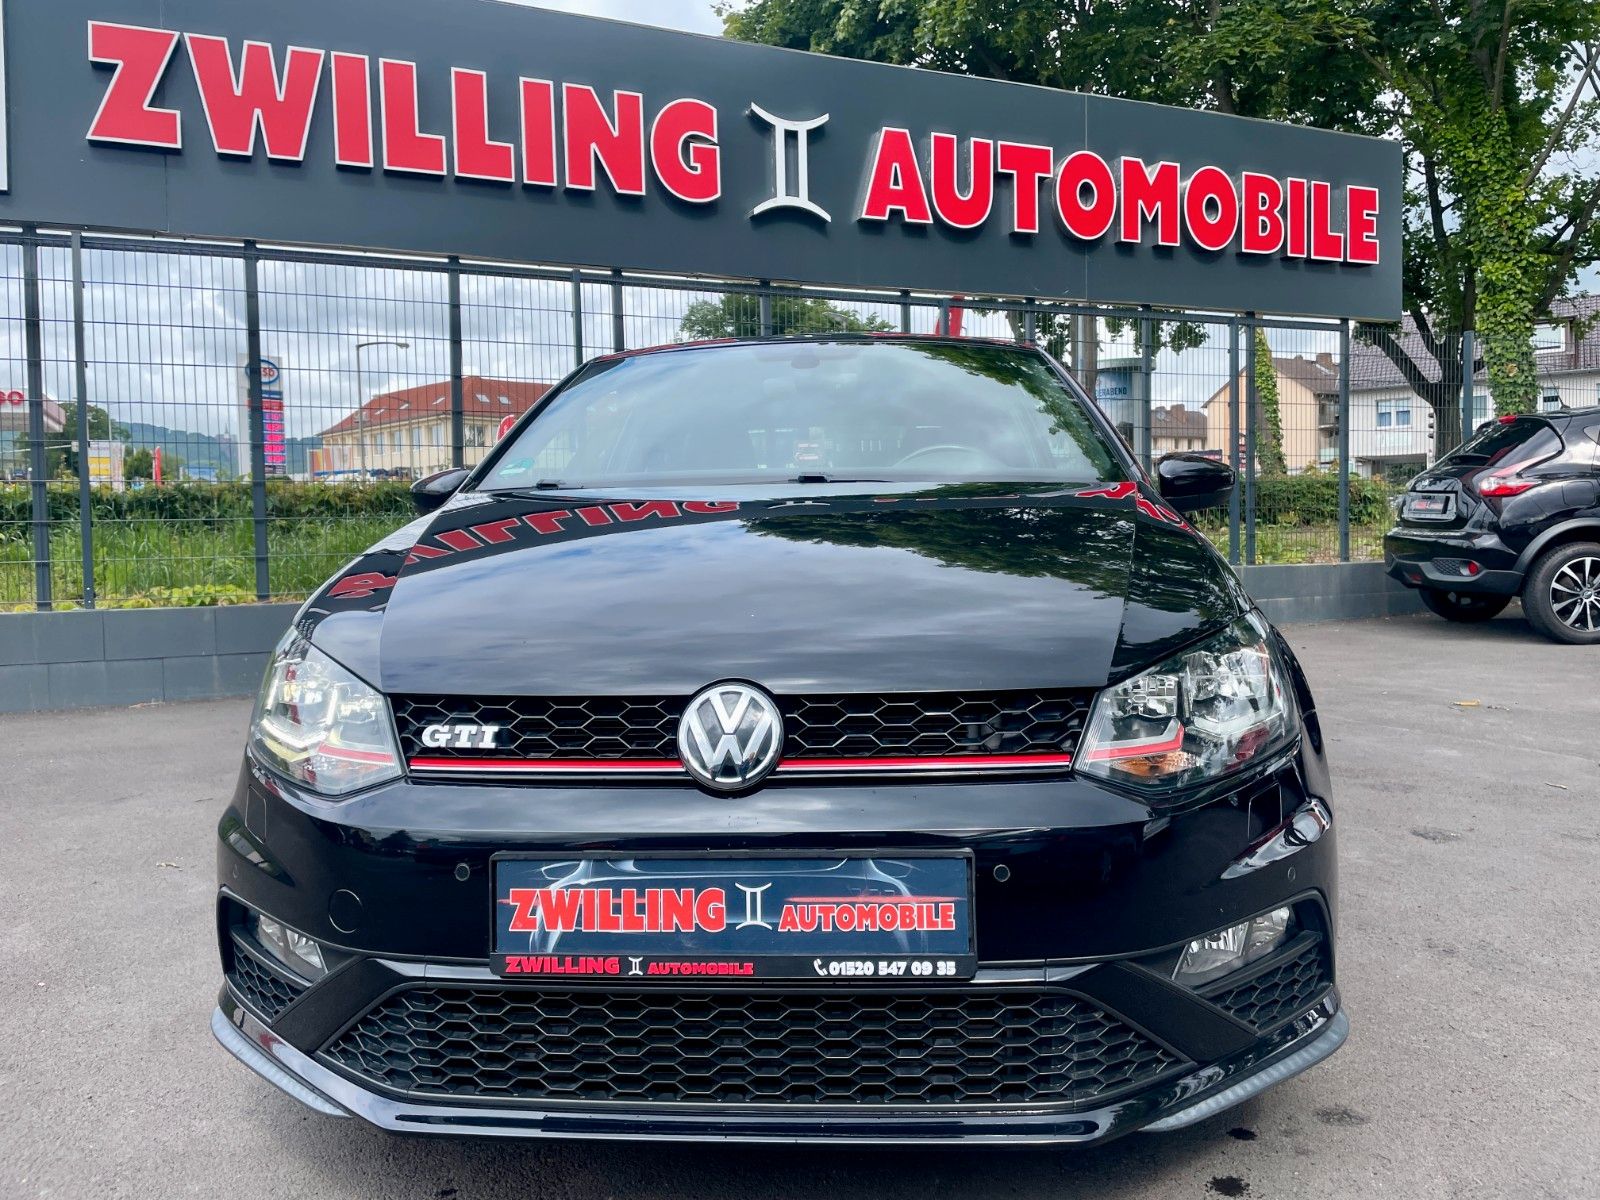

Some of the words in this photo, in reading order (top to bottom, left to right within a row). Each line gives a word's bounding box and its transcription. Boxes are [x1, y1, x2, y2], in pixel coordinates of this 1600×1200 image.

[86, 20, 721, 203] ZWILLING
[859, 127, 1380, 265] AUTOMOBILE
[421, 724, 499, 749] GTI
[681, 684, 781, 785] VW
[509, 887, 727, 933] ZWILLING
[778, 902, 956, 933] AUTOMOBILE
[505, 956, 620, 974] ZWILLING
[647, 962, 754, 975] AUTOMOBILE
[828, 961, 875, 976] 01520
[878, 961, 907, 976] 547
[911, 961, 933, 976] 09
[936, 961, 957, 976] 35
